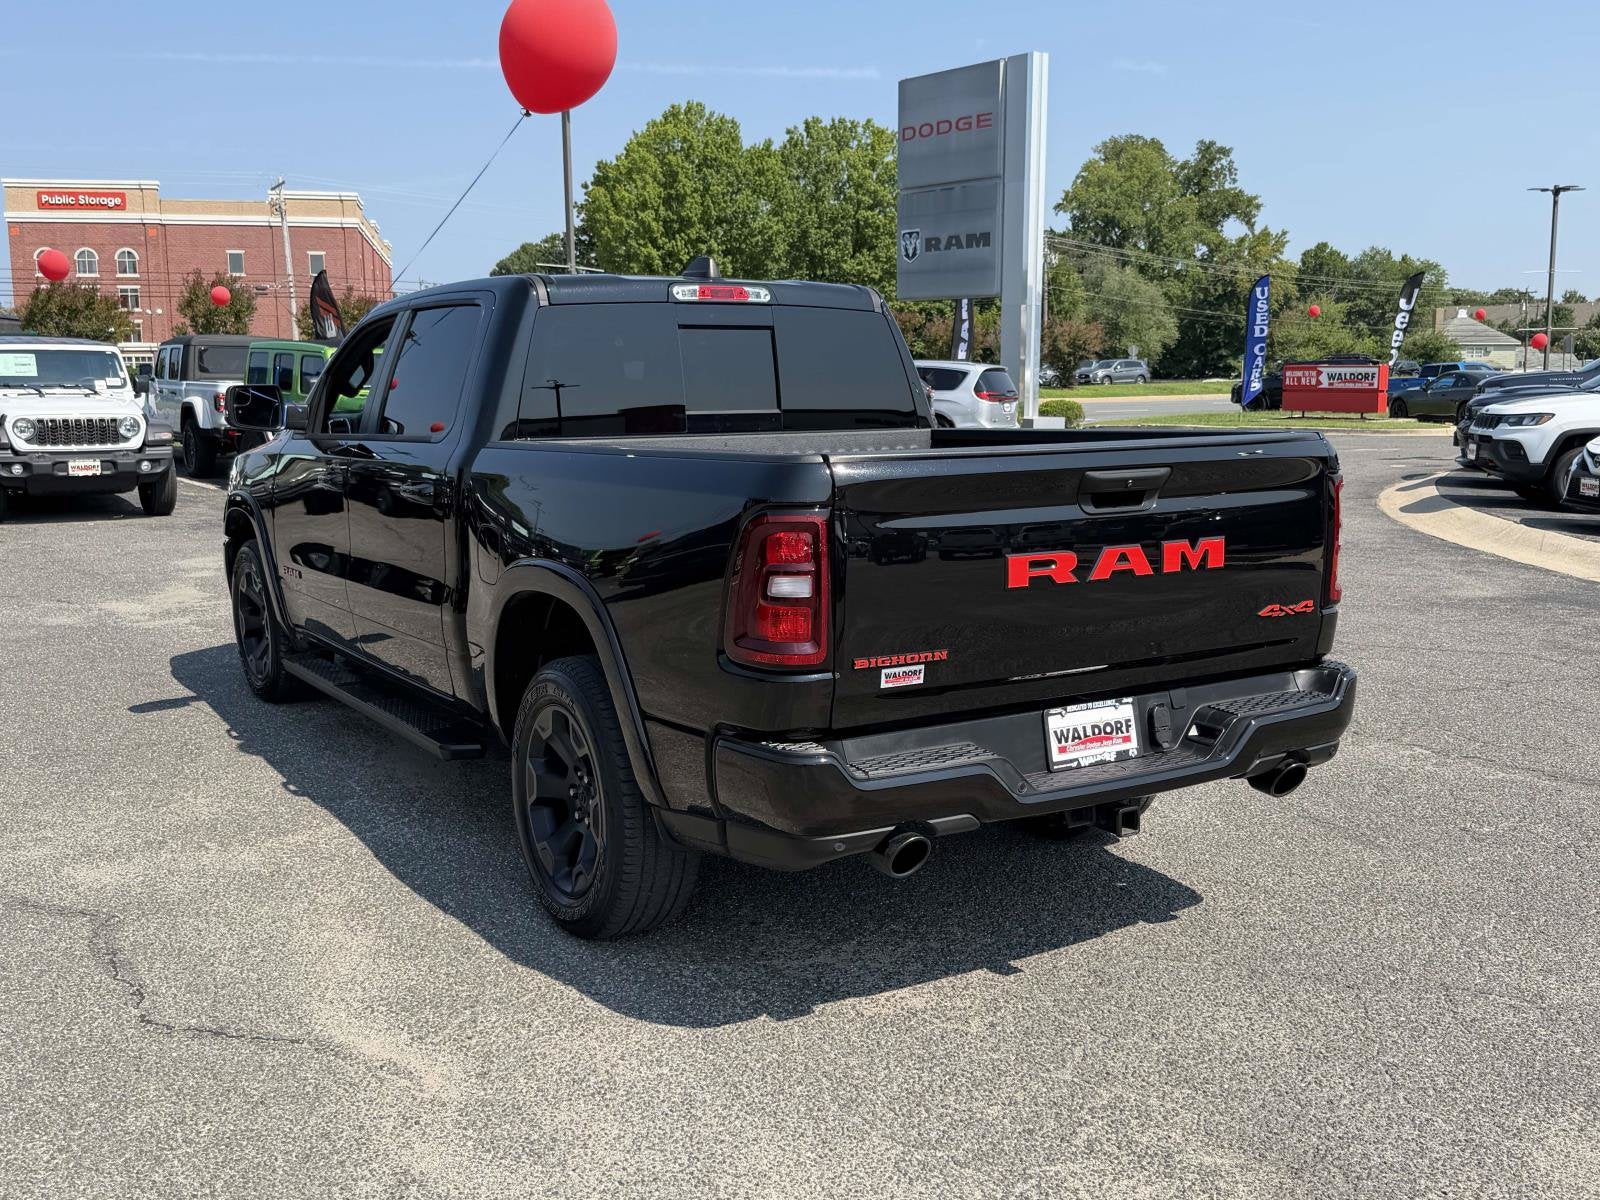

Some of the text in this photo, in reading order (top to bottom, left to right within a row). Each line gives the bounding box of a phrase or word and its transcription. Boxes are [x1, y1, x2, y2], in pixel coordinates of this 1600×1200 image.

[902, 112, 992, 142] DODGE
[41, 195, 122, 207] Public Storage
[924, 231, 991, 253] RAM
[957, 298, 969, 360] RAM
[1250, 287, 1269, 392] USED CARS
[1285, 376, 1317, 386] ALL NEW
[1327, 372, 1377, 381] WALDORF
[1004, 535, 1226, 589] RAM
[853, 650, 949, 670] BIGHORN
[884, 669, 923, 680] WALDORF
[1053, 719, 1132, 744] WALDORF
